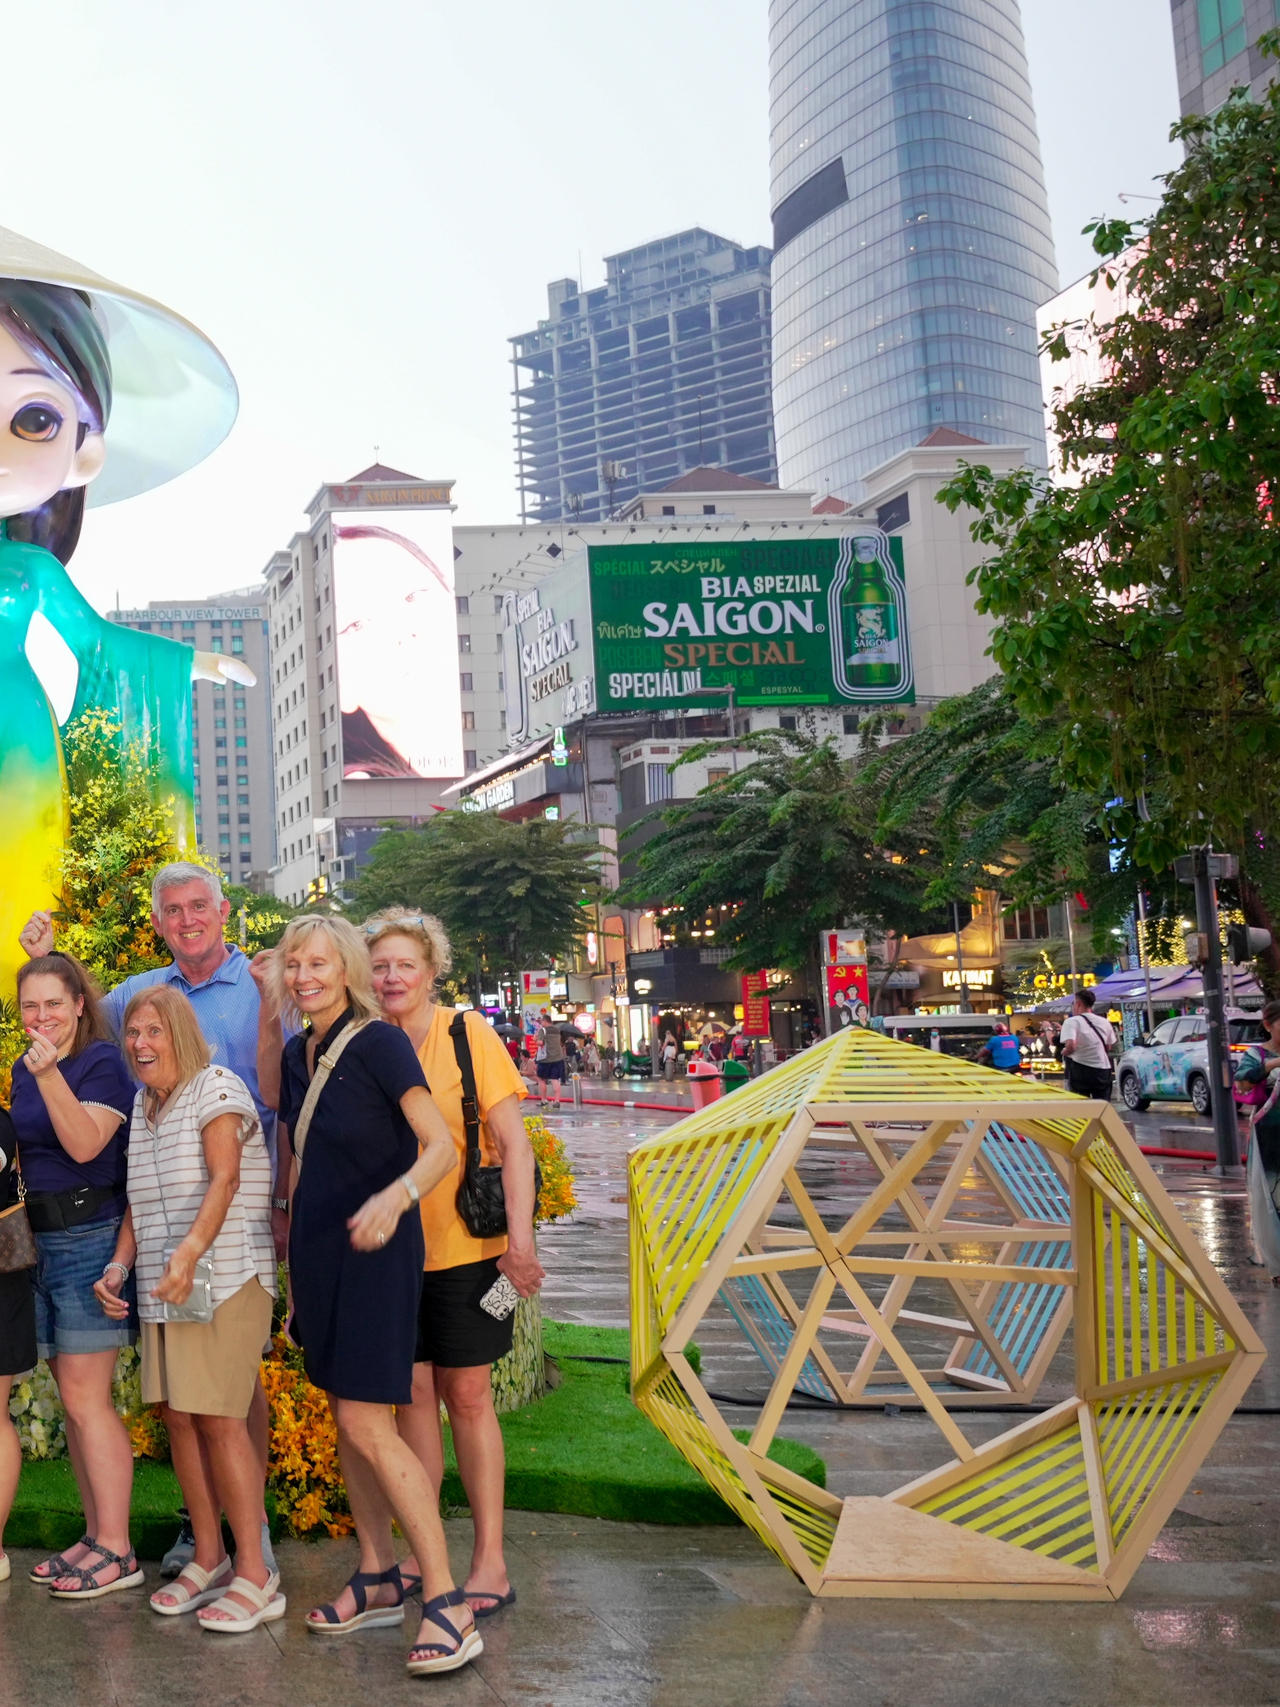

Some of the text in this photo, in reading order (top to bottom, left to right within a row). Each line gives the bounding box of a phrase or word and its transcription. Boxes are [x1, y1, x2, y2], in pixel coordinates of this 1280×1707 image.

[367, 490, 408, 505] SAIGON
[675, 548, 737, 558] СПЕЦИАЛЕН
[740, 545, 836, 572] SPECIAAL
[594, 559, 648, 576] SPÉCIAL
[649, 558, 726, 575] スペシャル
[700, 576, 754, 598] BIA
[753, 575, 821, 593] SPEZIAL
[126, 607, 260, 621] HARBOUR VIEW TOWER
[537, 607, 555, 634] BIA
[642, 599, 814, 638] SAIGON
[597, 621, 642, 639] พิเศษ
[523, 619, 575, 679] SAIGON
[854, 638, 889, 648] SAIGON
[599, 645, 661, 670] POSEBEN
[664, 641, 806, 668] SPECIAL
[530, 662, 573, 703] SPECIAL
[609, 668, 701, 699] SPECIÁLNÍ
[705, 670, 755, 687] 스페셜
[761, 686, 803, 694] ESPESYAL
[486, 779, 514, 808] GARDEN
[1238, 998, 1266, 1006] SUNWAH
[301, 1077, 324, 1128] MICHAEL KORS
